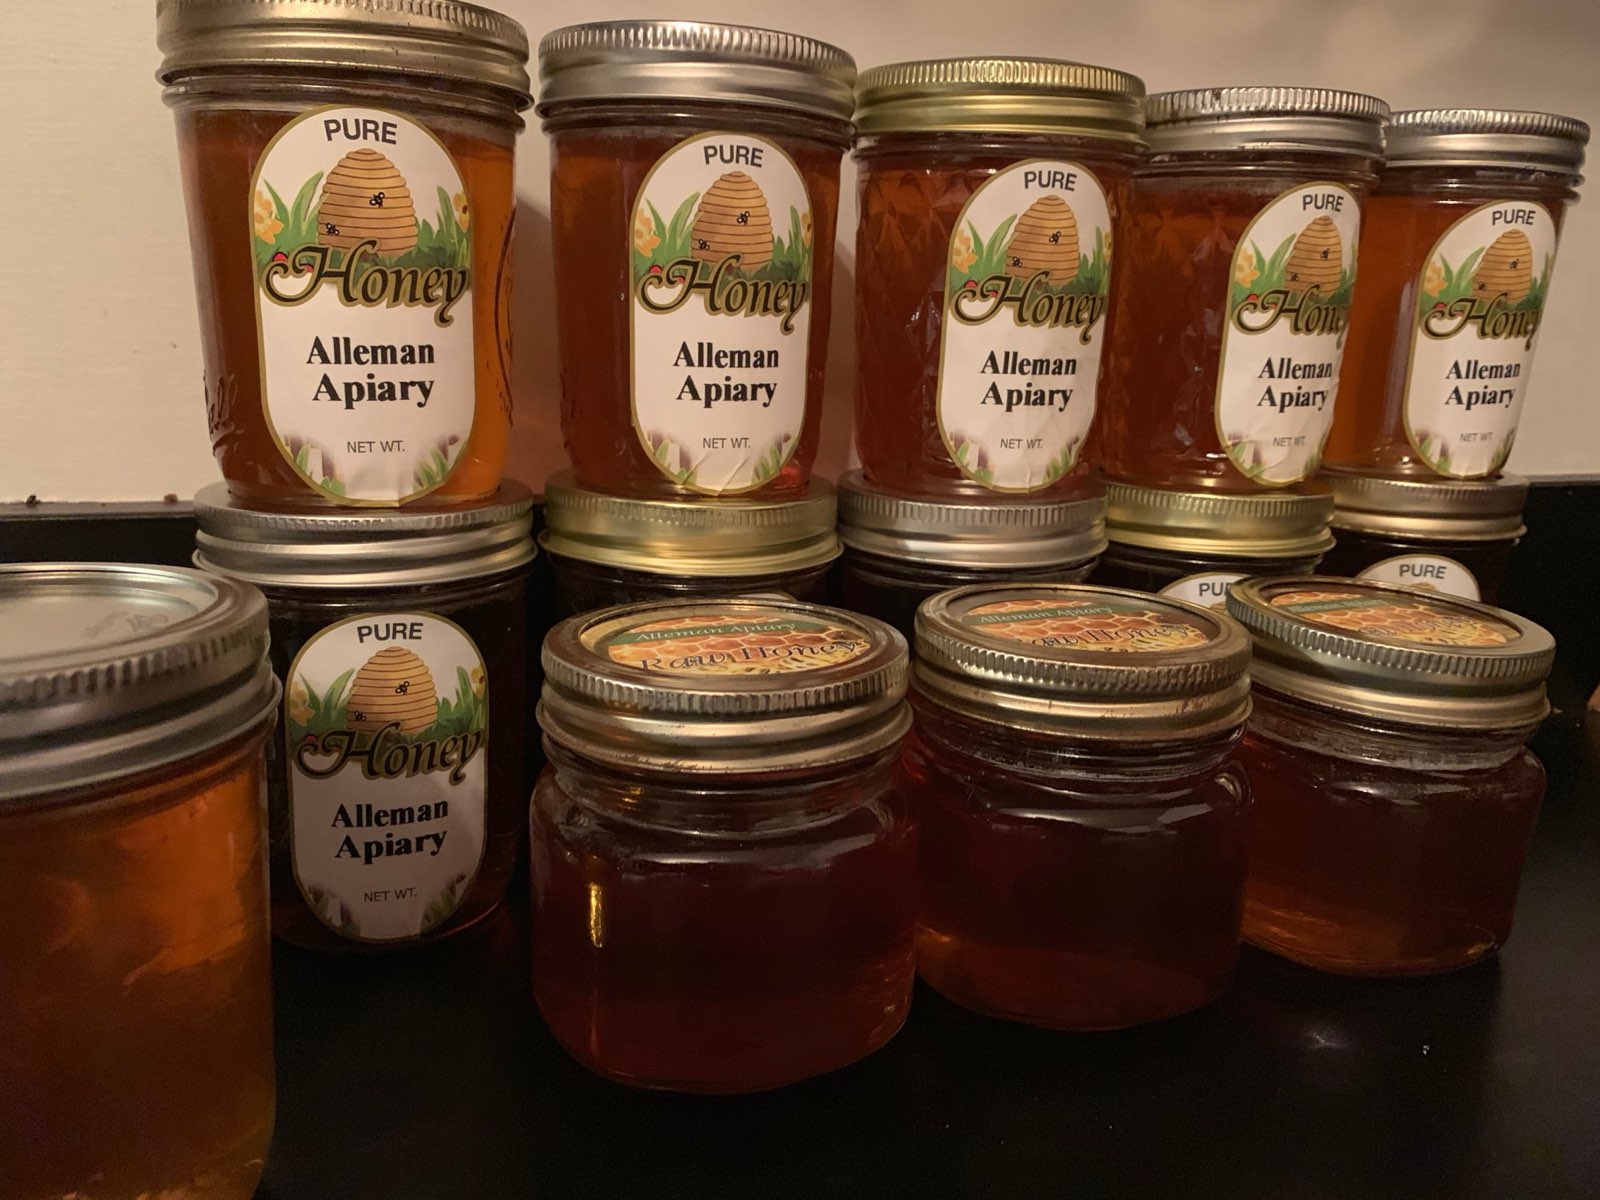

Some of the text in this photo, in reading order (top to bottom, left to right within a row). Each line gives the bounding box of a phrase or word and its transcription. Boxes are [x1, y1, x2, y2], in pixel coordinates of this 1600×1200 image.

[323, 118, 398, 145] PURE
[702, 145, 764, 168] PURE
[1023, 170, 1078, 192] PURE
[1302, 193, 1344, 212] PURE
[1491, 209, 1537, 226] PURE
[262, 238, 470, 327] Honey
[638, 253, 808, 335] Honey
[952, 270, 1105, 345] Honey
[305, 335, 436, 366] Alleman
[672, 341, 780, 369] Alleman
[979, 350, 1078, 376] Alleman
[1257, 357, 1333, 380] Alleman
[1444, 359, 1521, 381] Alleman
[311, 372, 435, 410] Apiary
[675, 374, 778, 409] Apiary
[980, 381, 1074, 412] Apiary
[1256, 385, 1329, 413] Apiary
[1444, 385, 1517, 411] Apiary
[346, 440, 406, 454] NET WT.
[702, 438, 727, 449] NET
[999, 438, 1023, 449] NET
[1272, 436, 1293, 447] NET
[1399, 563, 1447, 579] PURE
[1198, 581, 1233, 597] PU
[980, 605, 1113, 623] Alleman Apiary
[356, 622, 425, 643] PURE
[635, 621, 797, 641] Alleman Apiary
[741, 639, 859, 661] Honey
[295, 722, 484, 786] Honey
[330, 799, 450, 829] Alleman
[334, 830, 449, 866] Apiary
[363, 888, 418, 903] NET WT.
